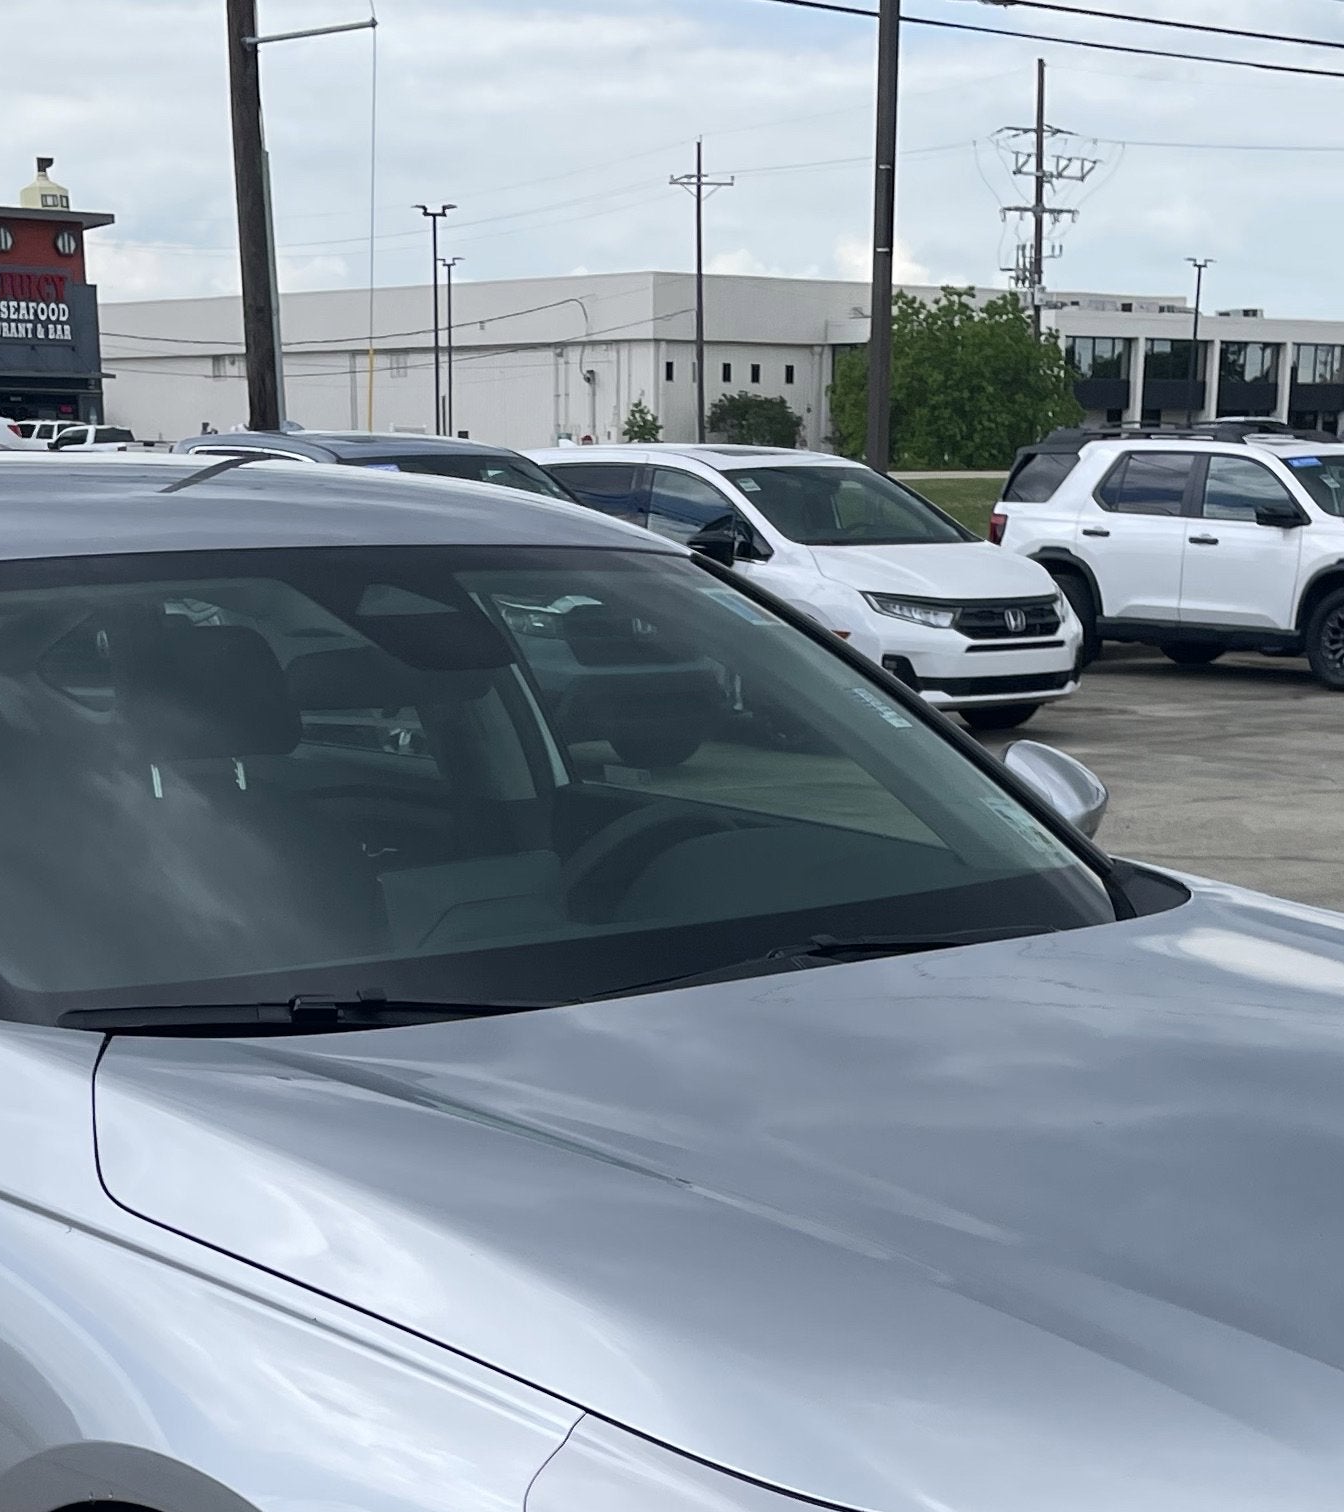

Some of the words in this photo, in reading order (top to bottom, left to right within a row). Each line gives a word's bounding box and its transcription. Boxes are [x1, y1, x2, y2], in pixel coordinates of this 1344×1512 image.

[0, 301, 70, 321] SEAFOOD
[36, 323, 45, 339] &
[48, 323, 72, 340] BAR
